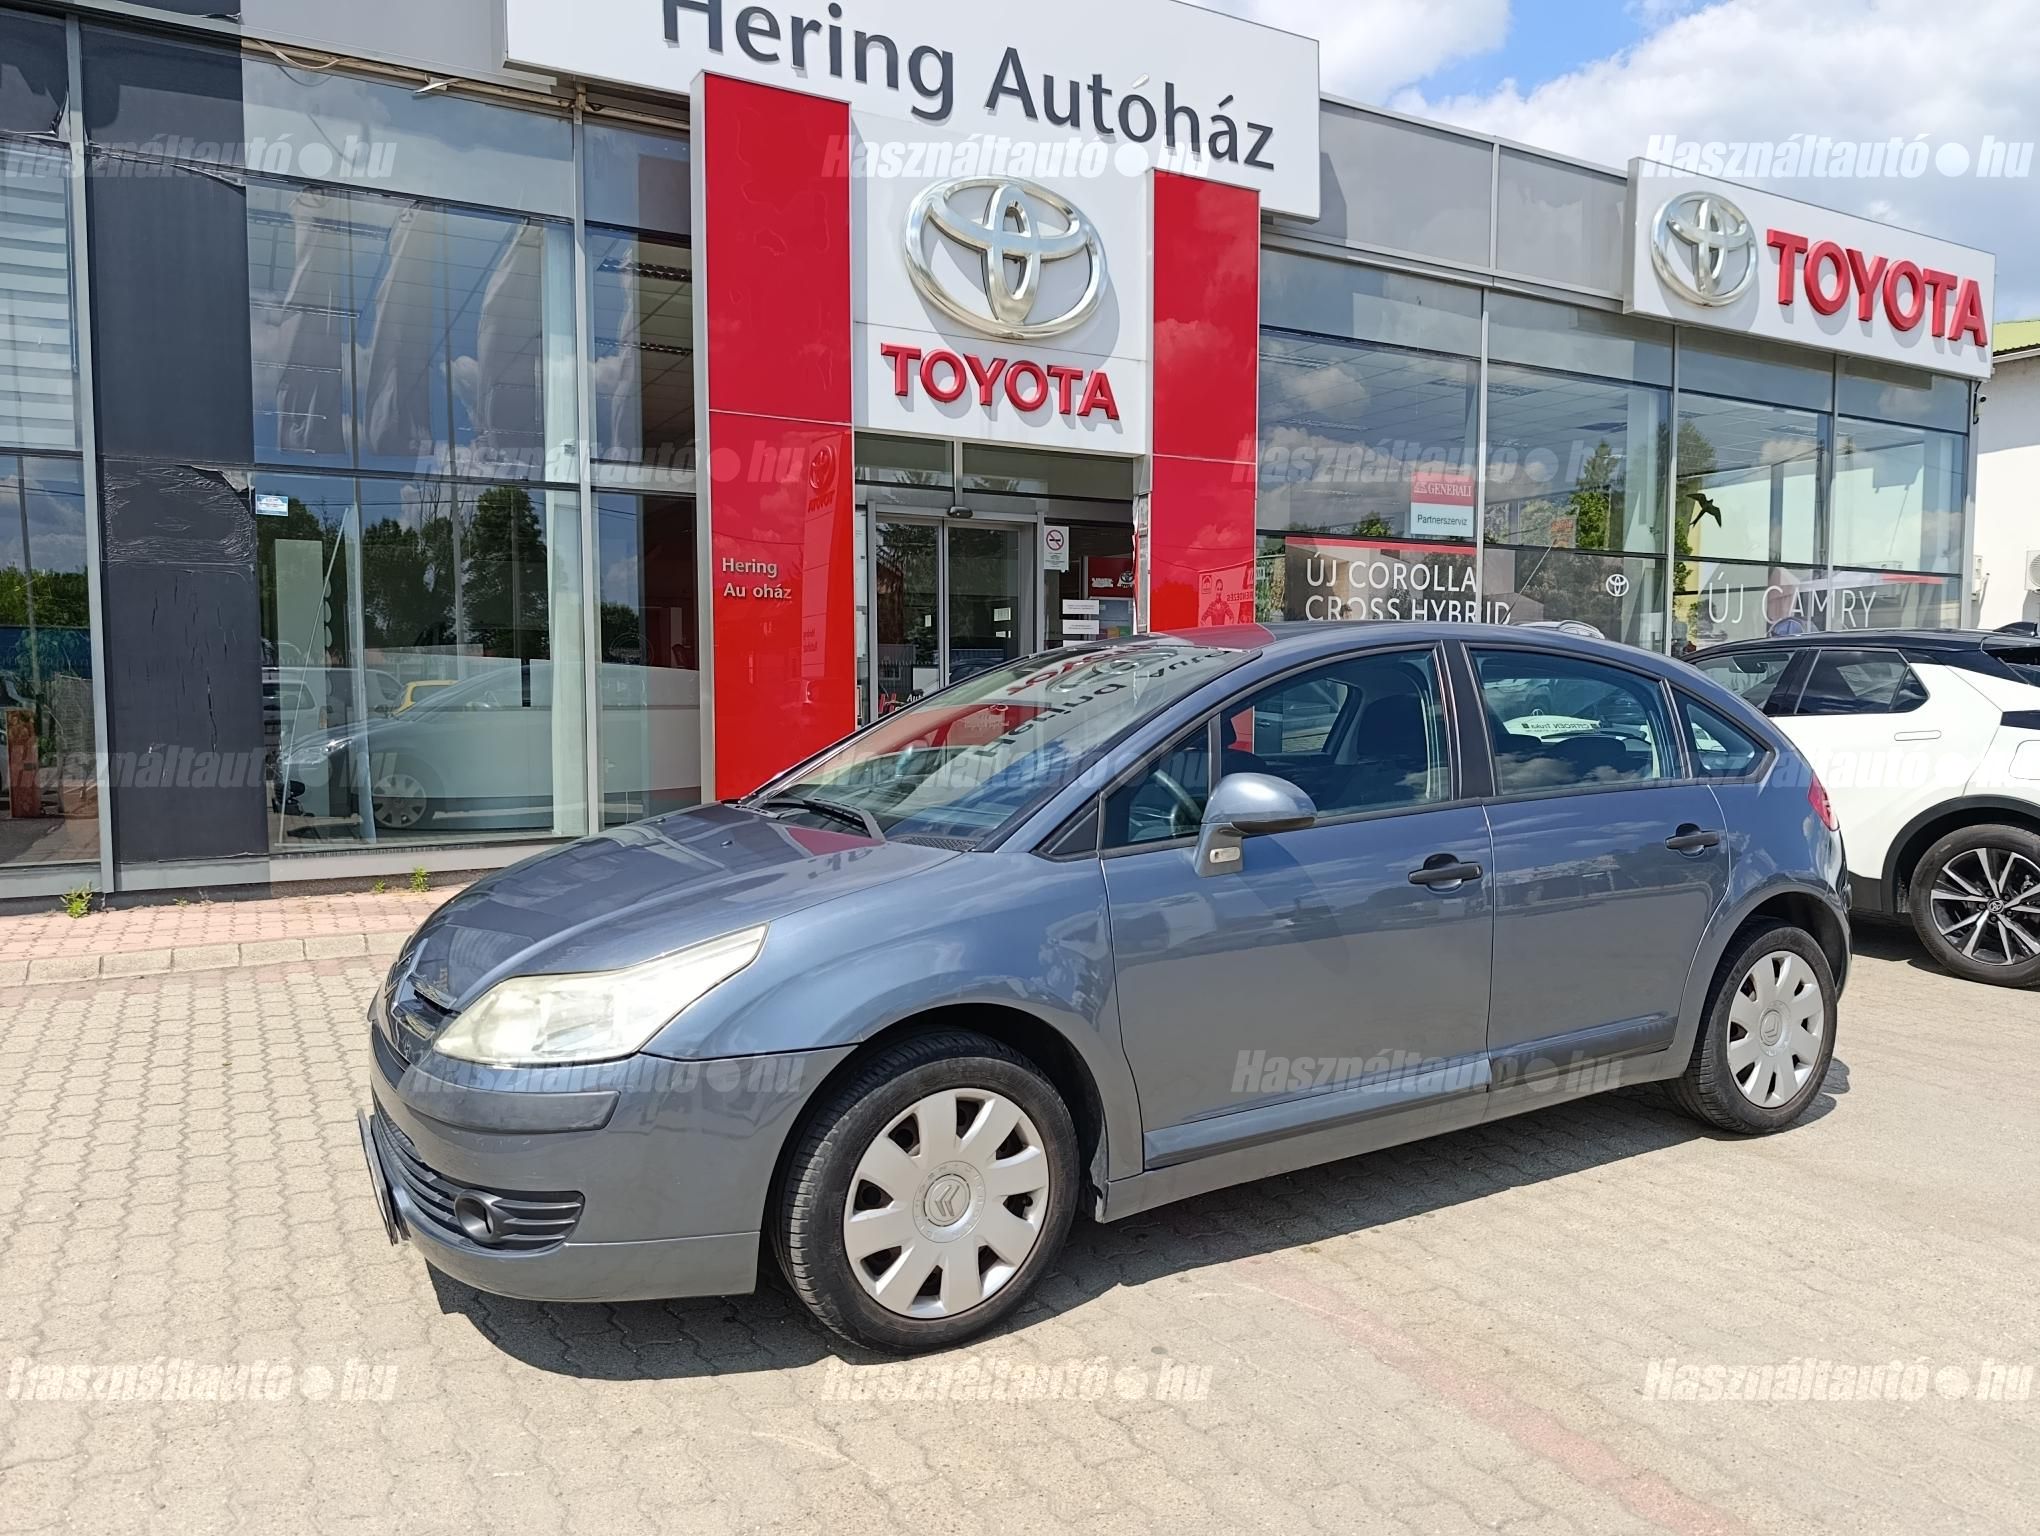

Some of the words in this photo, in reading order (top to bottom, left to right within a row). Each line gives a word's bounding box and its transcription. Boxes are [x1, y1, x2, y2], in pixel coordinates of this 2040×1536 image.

[662, 0, 953, 121] Hering
[983, 46, 1275, 171] Autóház
[1766, 228, 1988, 347] TOYOTA
[880, 341, 1120, 421] TOYOTA
[1427, 482, 1472, 498] GENERALI
[1417, 513, 1469, 527] Partnerszerviz
[721, 557, 778, 578] Hering
[1305, 552, 1336, 587] ÚJ
[1348, 560, 1476, 593] COROLLA
[1305, 595, 1401, 622] CROSS
[1412, 599, 1511, 625] HYBRID
[1708, 571, 1744, 624] ÚJ
[1761, 585, 1877, 628] CAMRY
